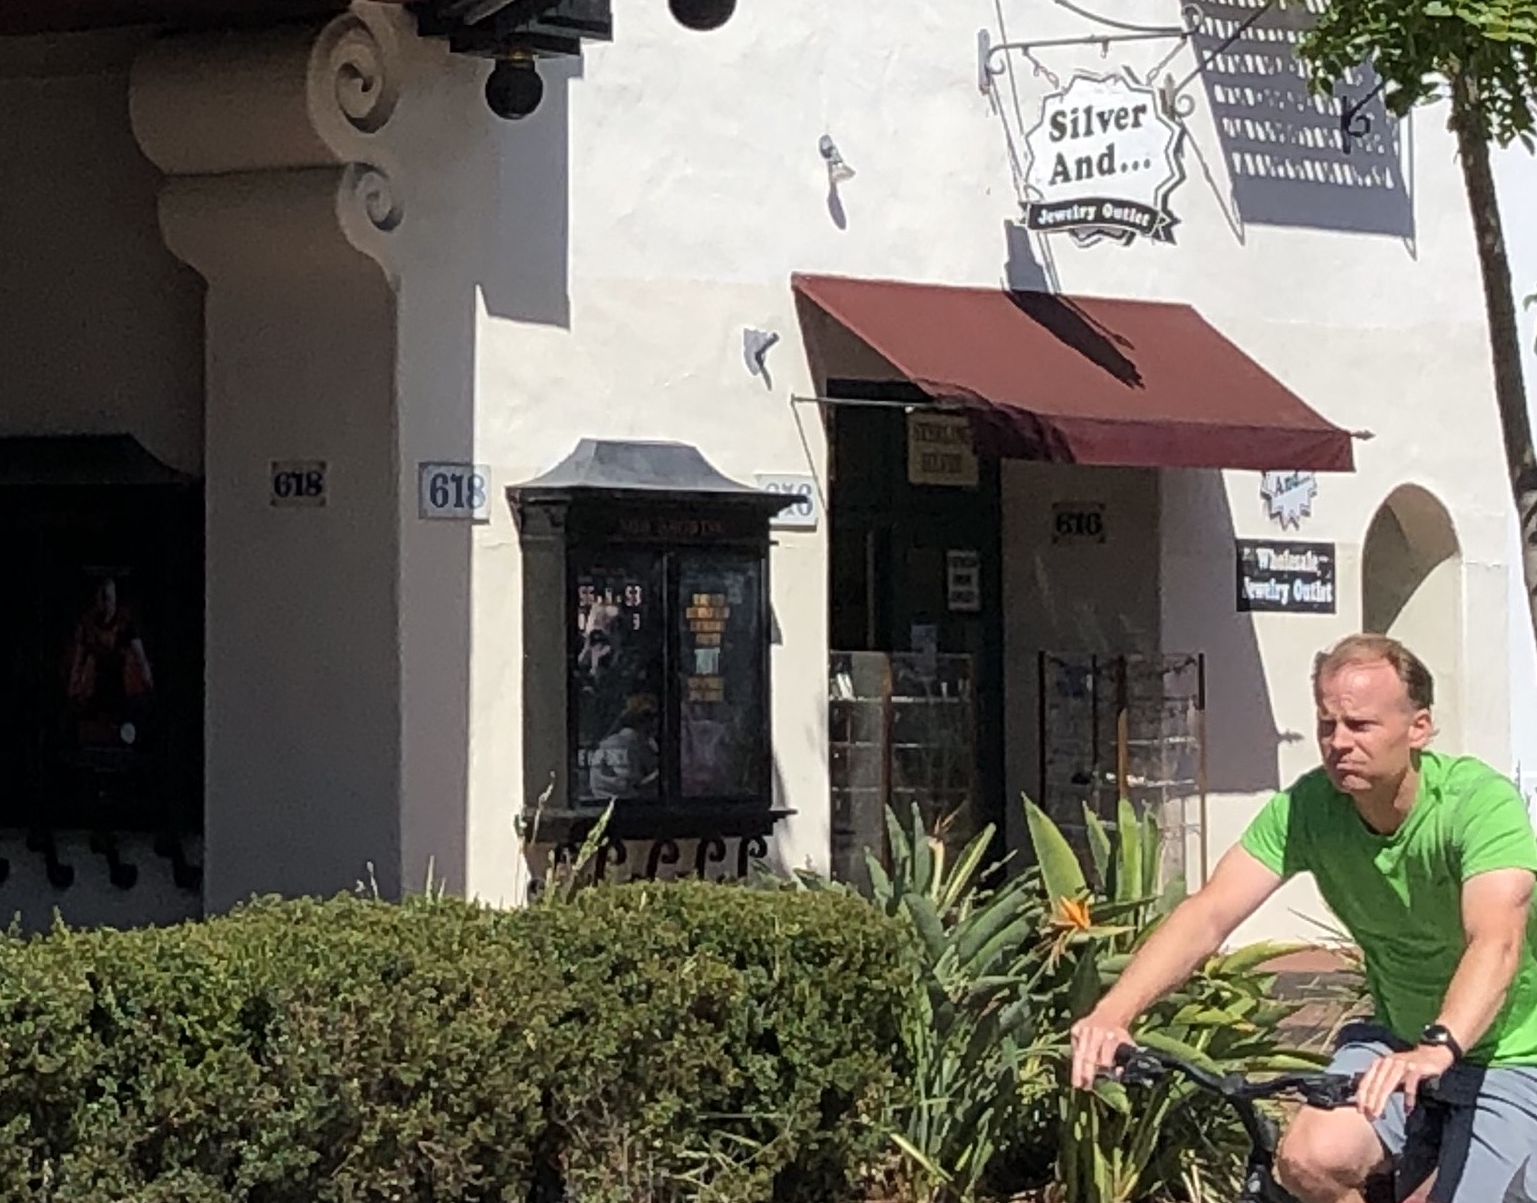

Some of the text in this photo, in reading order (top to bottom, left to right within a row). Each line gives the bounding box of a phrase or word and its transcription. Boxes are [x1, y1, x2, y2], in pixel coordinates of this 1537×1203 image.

[1048, 103, 1148, 143] Silver
[1048, 142, 1152, 186] And...
[273, 469, 324, 498] 618
[430, 472, 486, 510] 618
[1056, 512, 1103, 536] 616
